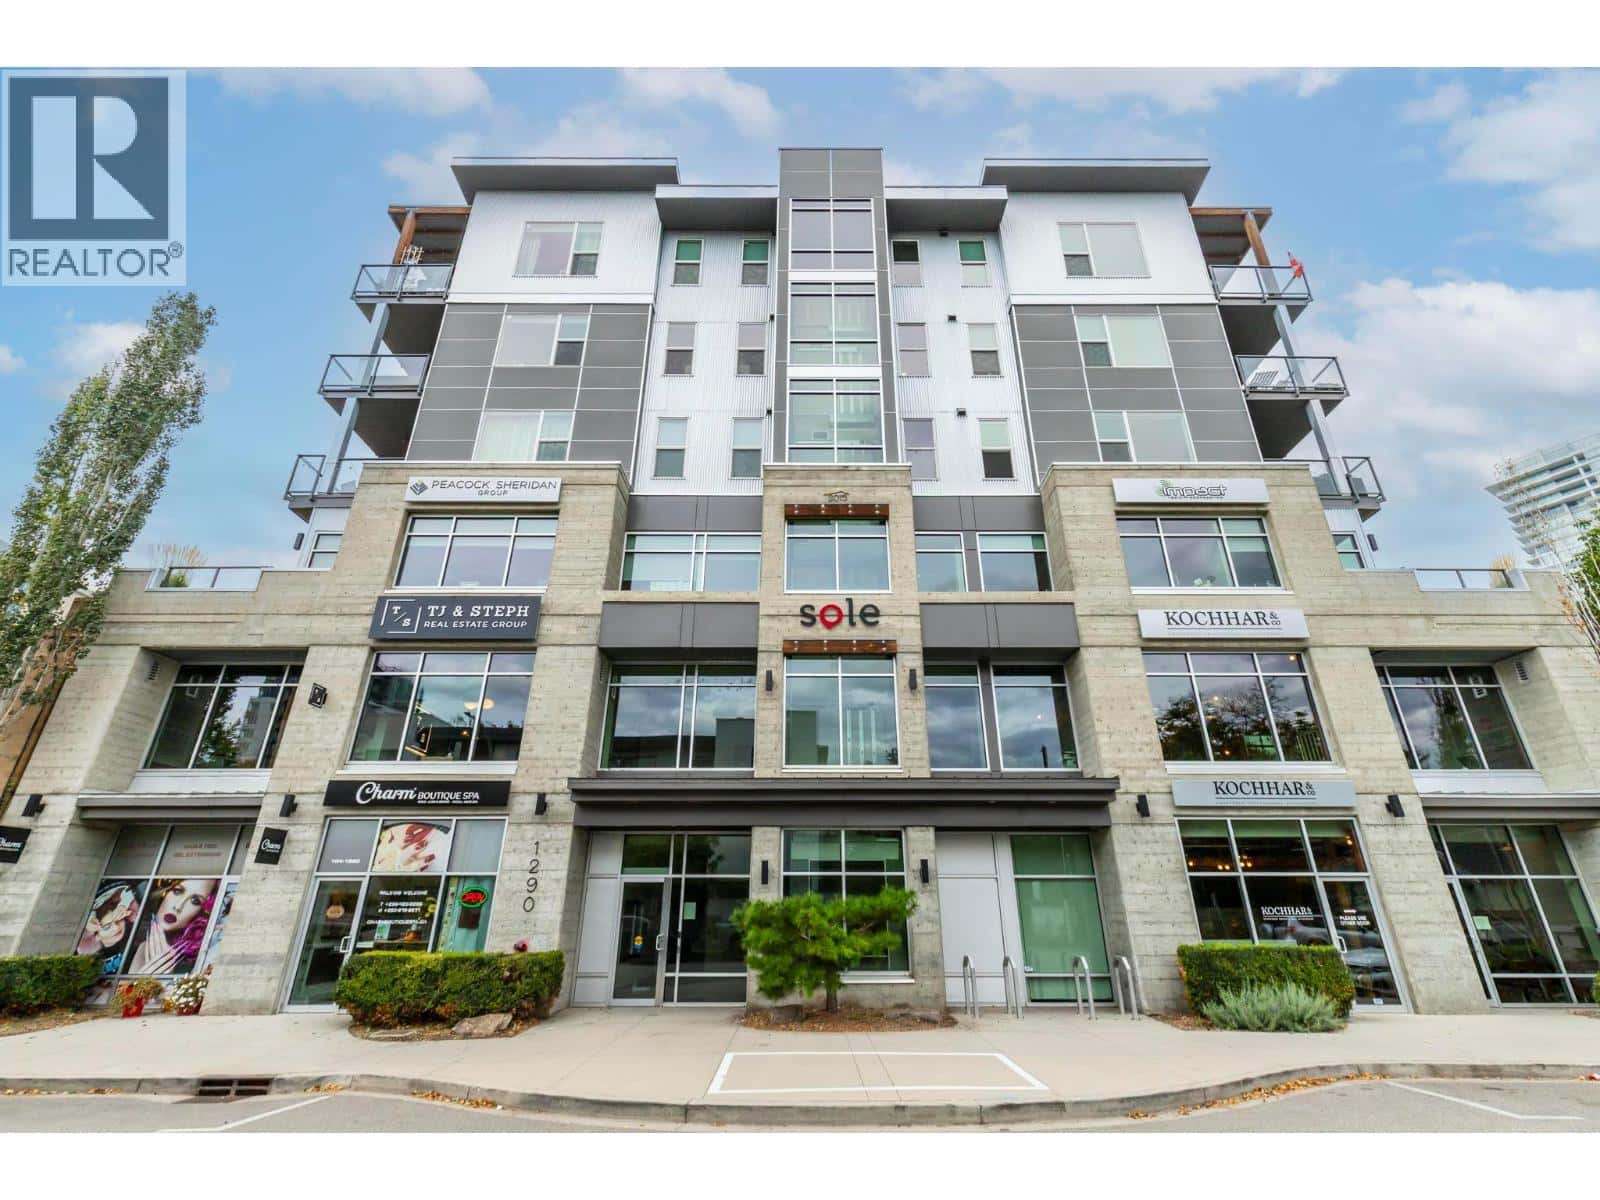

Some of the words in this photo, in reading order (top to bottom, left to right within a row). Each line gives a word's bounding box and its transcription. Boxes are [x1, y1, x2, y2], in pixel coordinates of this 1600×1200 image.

[432, 480, 489, 489] PEACOCK
[496, 480, 557, 490] SHERIDAN
[428, 606, 446, 617] TJ
[453, 606, 463, 617] &
[470, 605, 530, 617] STEPH
[800, 598, 881, 629] sole
[1164, 611, 1270, 626] KOCHHAR
[356, 781, 418, 804] Charm
[418, 791, 462, 800] BOUTIQUE
[462, 791, 480, 800] SPA
[1212, 781, 1306, 795] KOCHHAR
[523, 841, 540, 913] 1290
[1261, 906, 1307, 915] KOCHHAR
